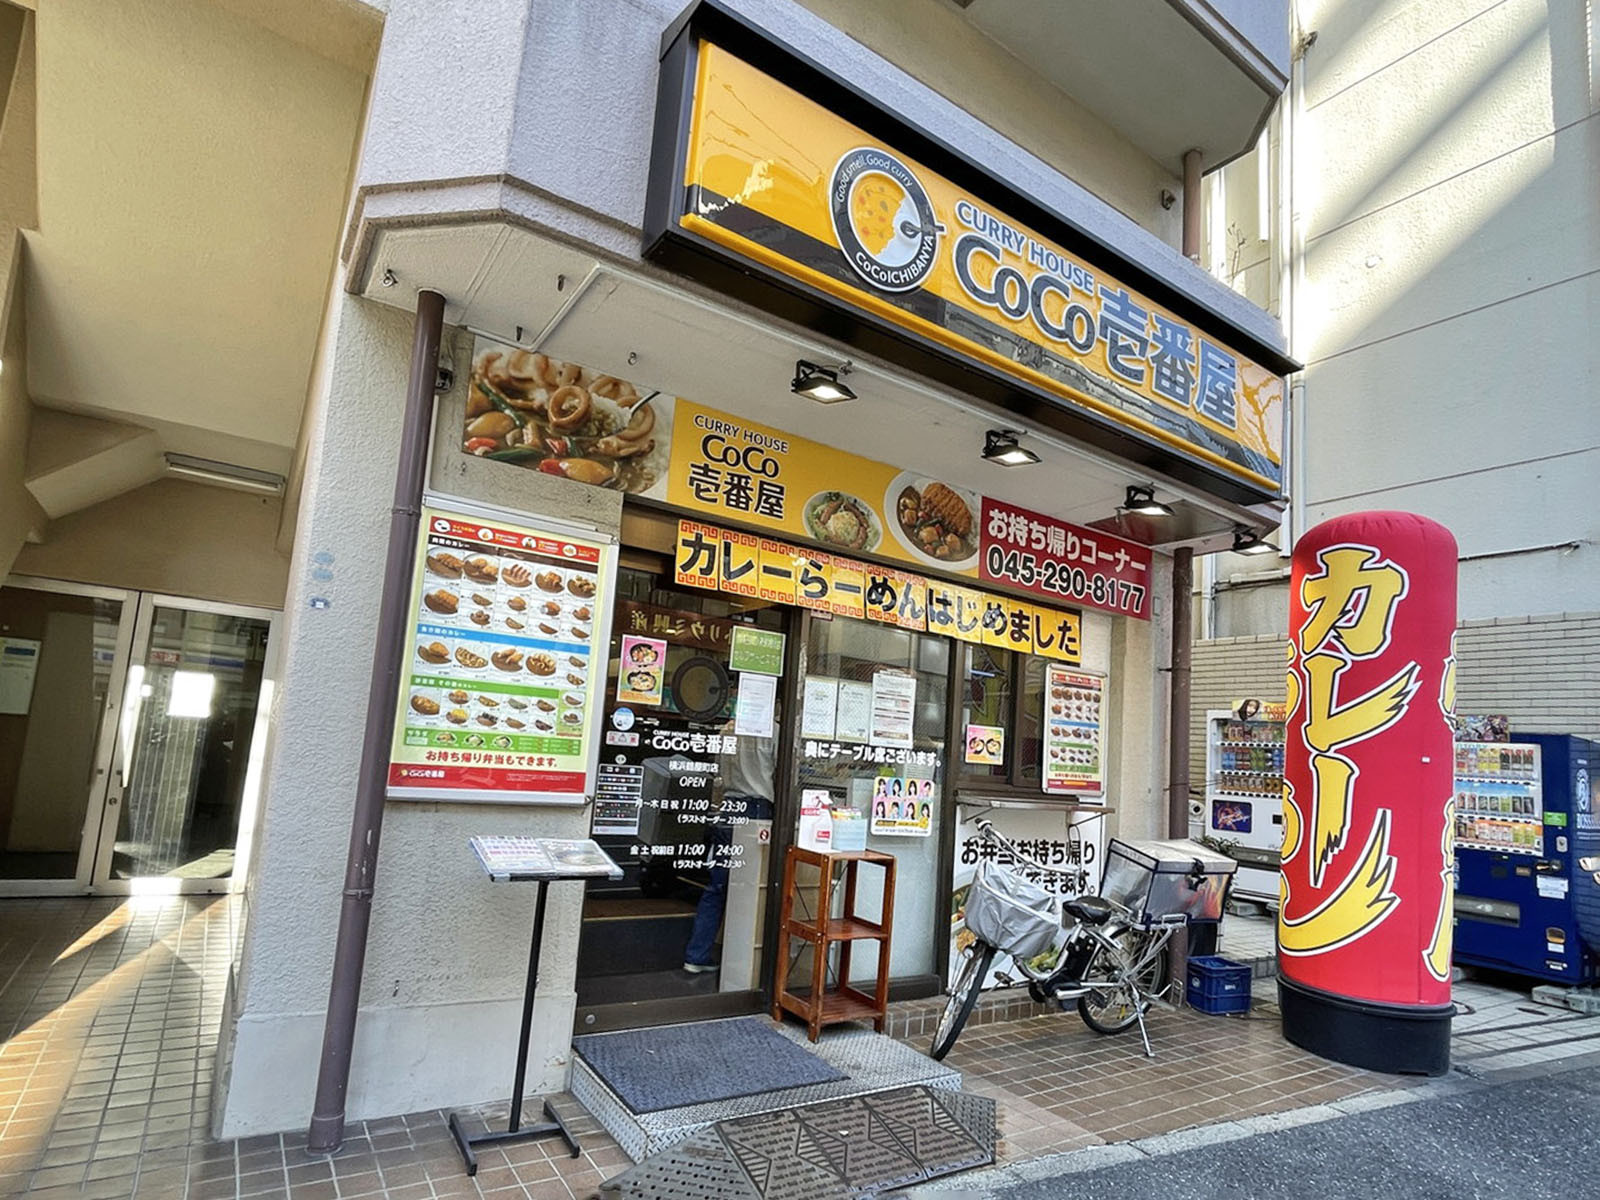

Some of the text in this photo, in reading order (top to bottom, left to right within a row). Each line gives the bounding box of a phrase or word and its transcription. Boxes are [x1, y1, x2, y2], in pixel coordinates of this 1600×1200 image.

[836, 171, 850, 203] Good
[866, 153, 891, 170] Good
[891, 165, 913, 188] curry
[855, 235, 935, 284] CoCoICHIBANYA
[955, 201, 1094, 296] CURRY HOUSE
[694, 414, 789, 454] CURRY HOUSE
[701, 433, 780, 479] CoCo
[688, 463, 786, 520] 壱番屋
[988, 508, 1147, 573] お持ち帰りコーナー
[679, 531, 1080, 657] カレーらーめんはじめました
[986, 544, 1145, 613] 045-290-8177
[804, 741, 942, 767] 奥にテーブル席ございます。
[679, 776, 707, 788] OPEN
[682, 799, 709, 811] 11:00
[719, 801, 748, 813] 23:30
[678, 844, 706, 856] 11:00
[716, 845, 744, 857] 24:00
